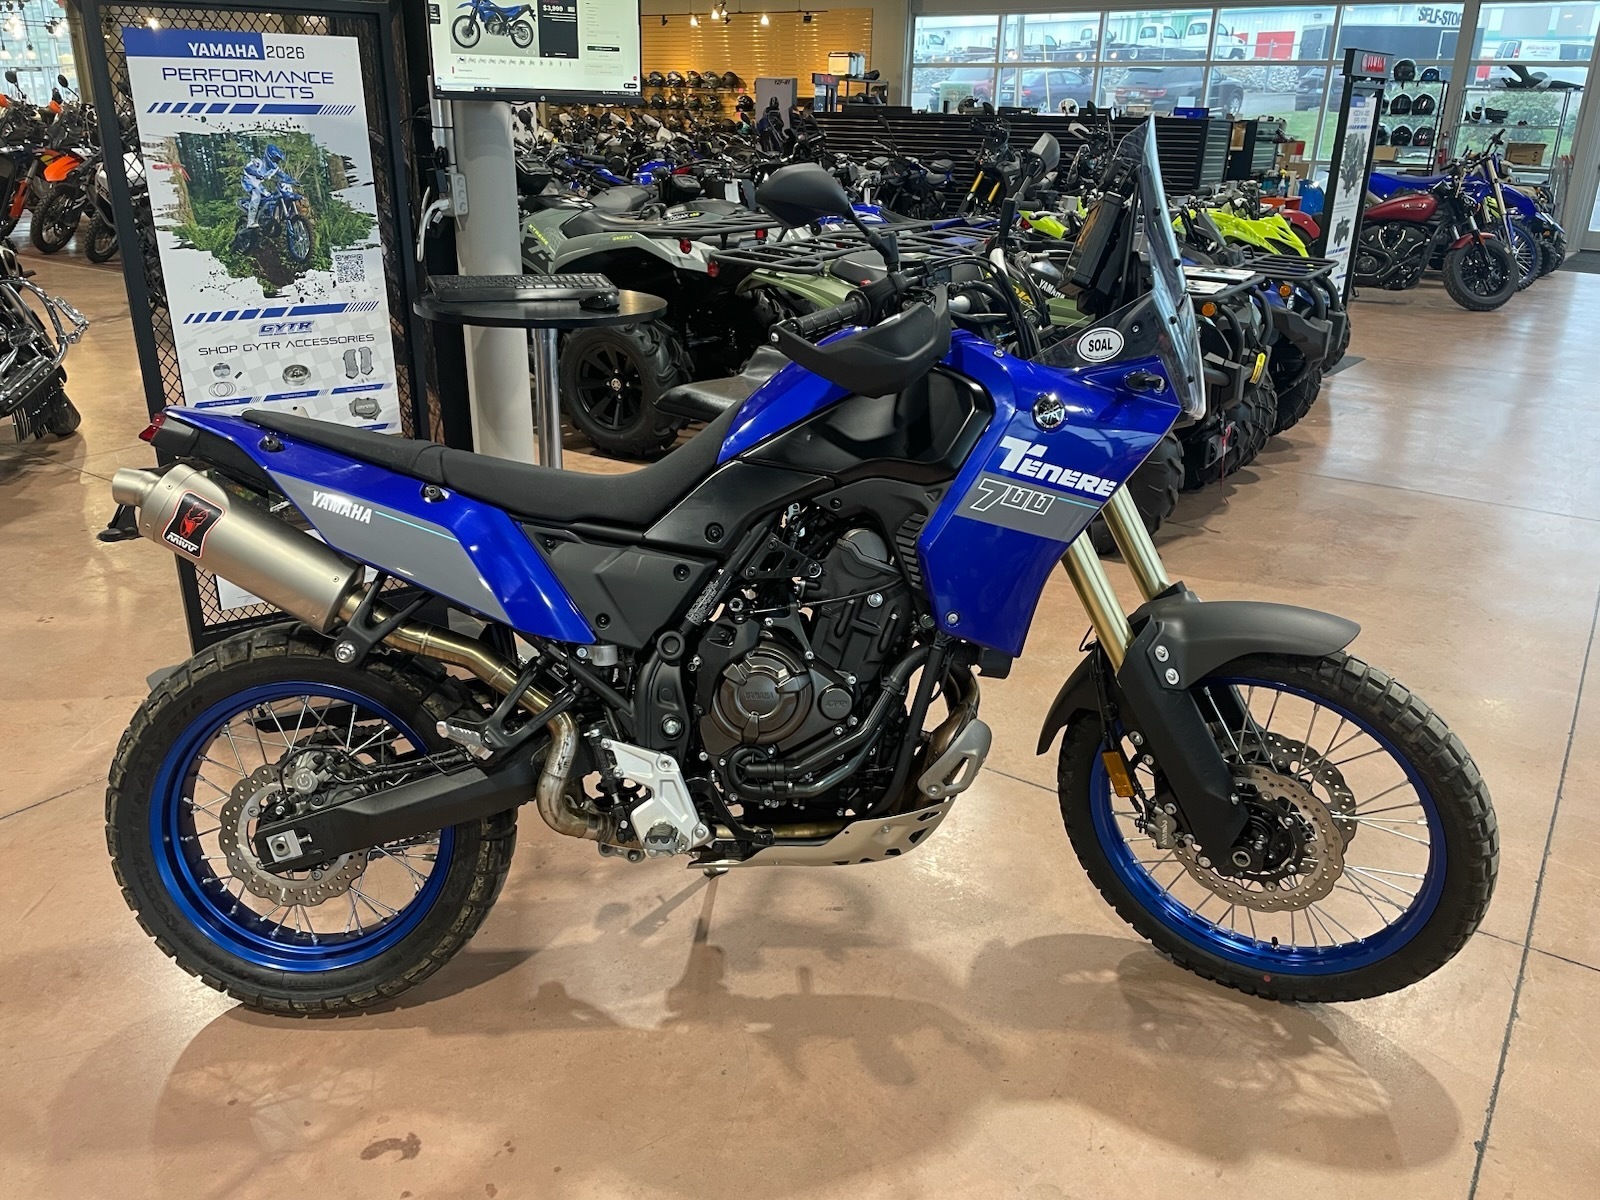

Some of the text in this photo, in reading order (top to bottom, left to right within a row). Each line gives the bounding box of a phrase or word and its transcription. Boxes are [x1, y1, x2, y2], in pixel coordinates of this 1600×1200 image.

[187, 42, 305, 60] YAMAHA 2026
[162, 67, 335, 85] PERFORMANCE
[189, 84, 315, 99] PRODUCTS
[257, 320, 314, 335] GYTR
[198, 345, 238, 356] SHOP
[243, 341, 281, 352] GYTR
[285, 333, 375, 349] ACCESSORIES
[1088, 338, 1113, 352] SOAL
[970, 477, 1057, 516] 700
[311, 490, 373, 524] YAMAHA
